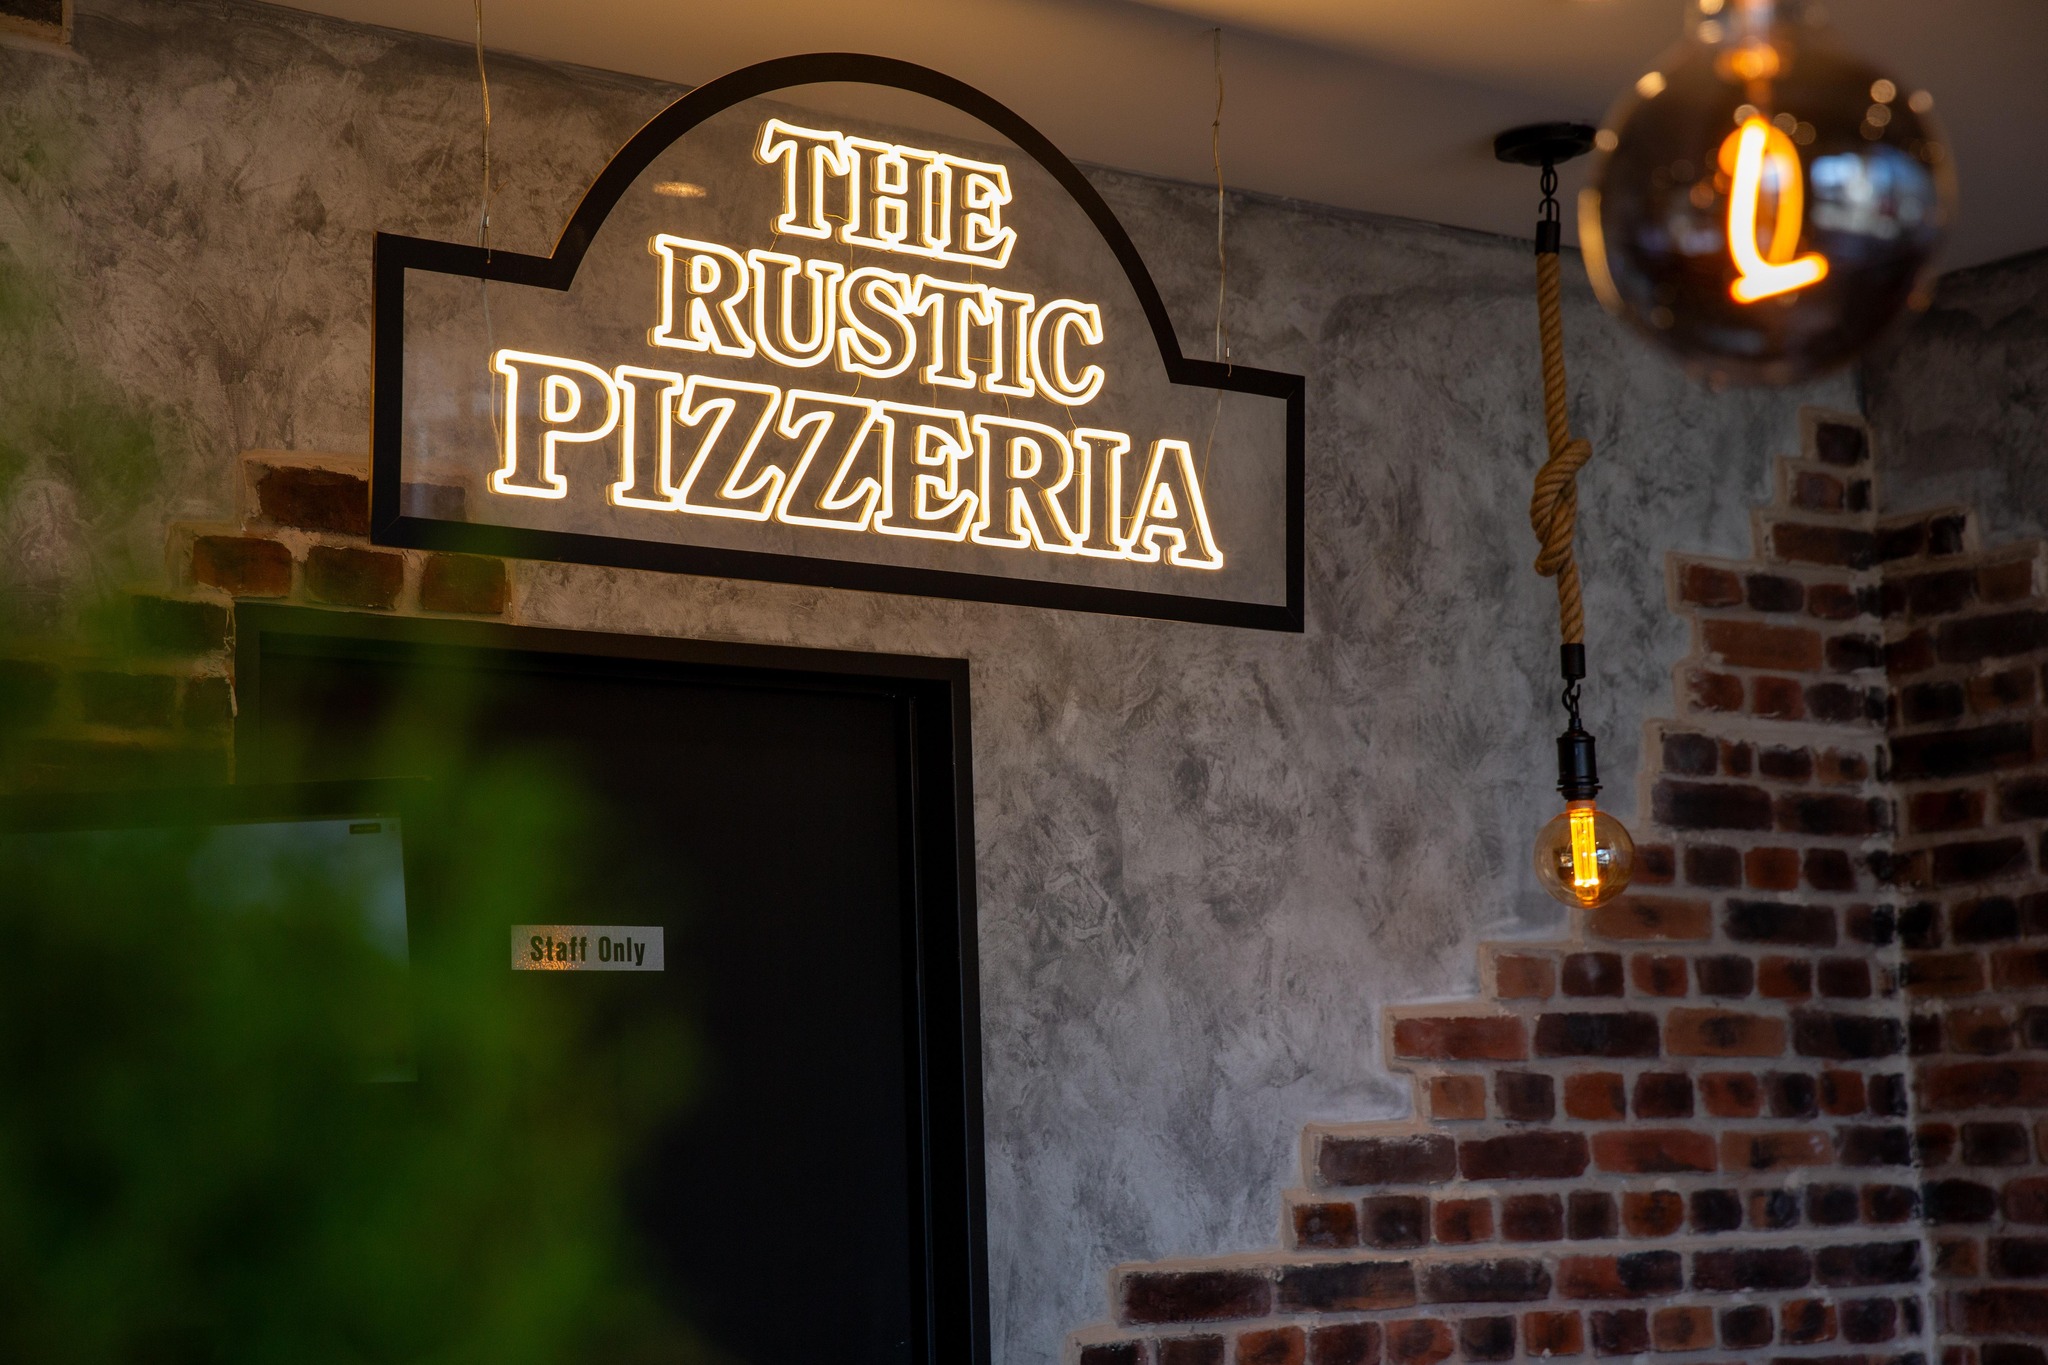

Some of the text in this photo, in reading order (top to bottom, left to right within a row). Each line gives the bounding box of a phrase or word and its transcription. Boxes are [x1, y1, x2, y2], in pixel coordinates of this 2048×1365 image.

[756, 118, 1018, 269] THE
[649, 233, 1105, 406] RUSTIC
[489, 348, 1224, 570] PIZZERIA
[530, 935, 646, 966] Staff Only
